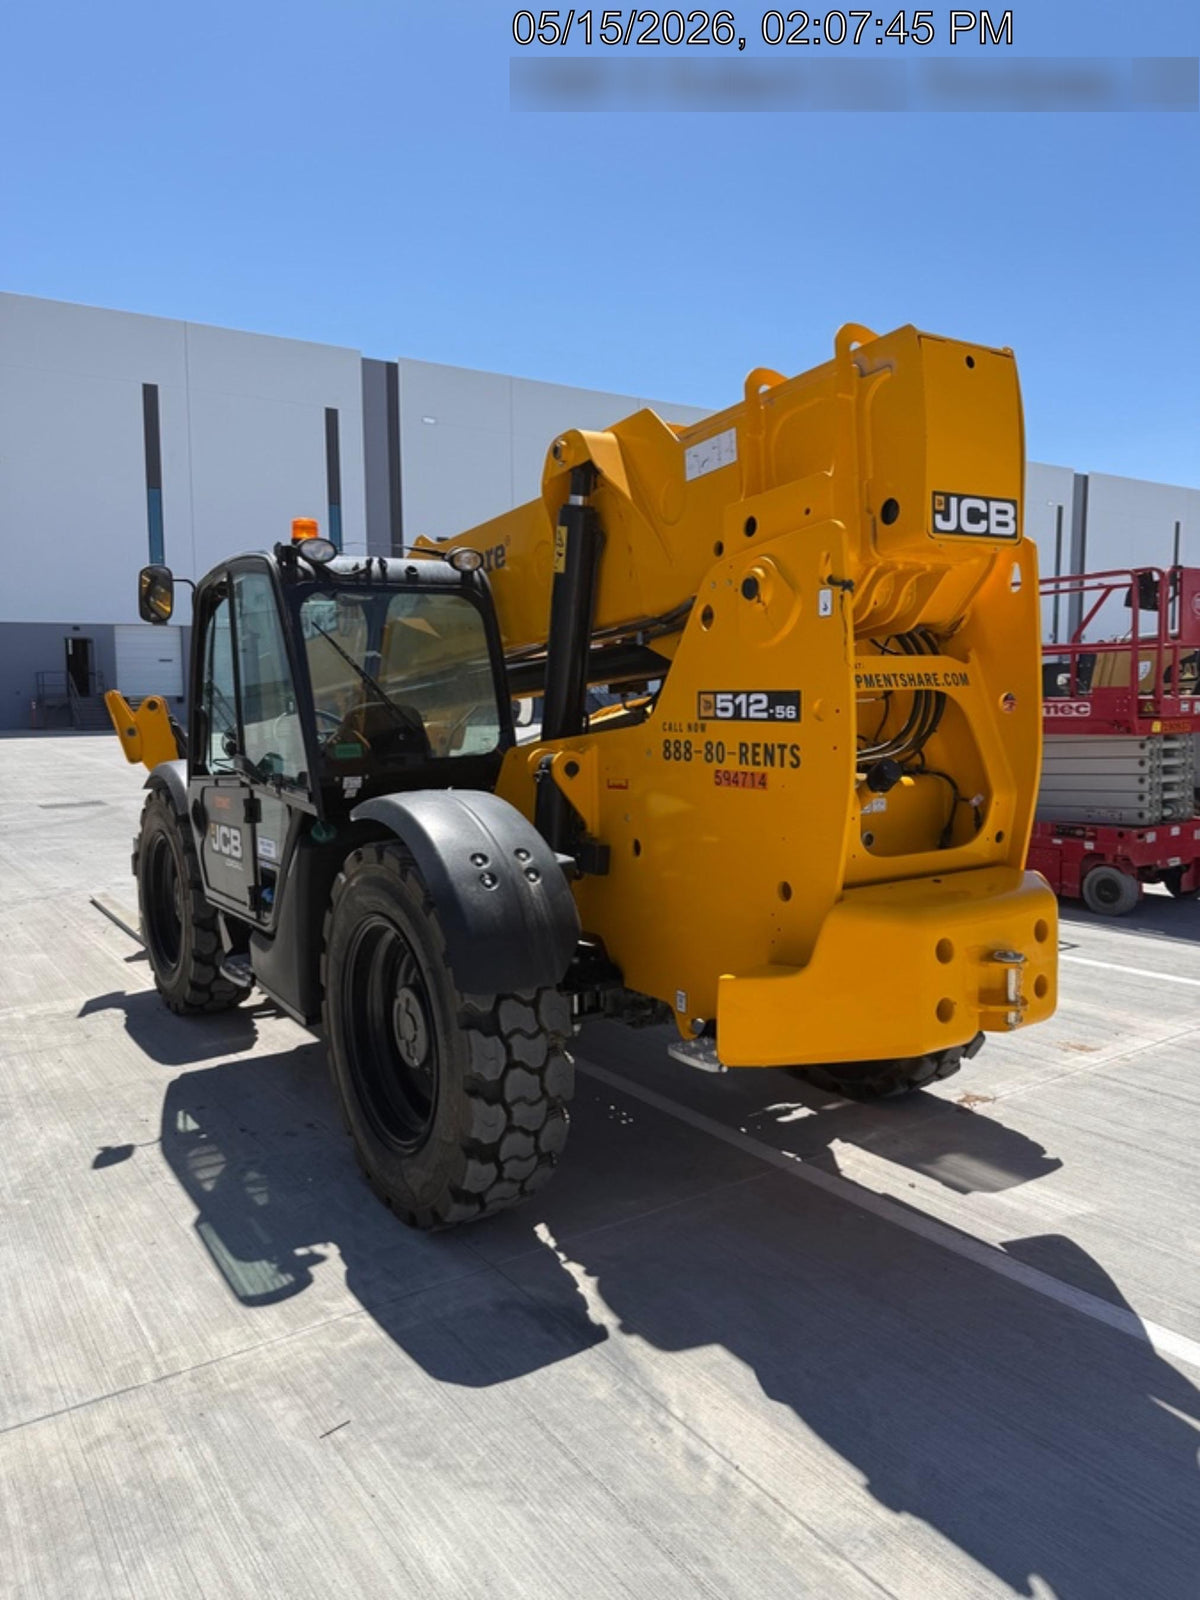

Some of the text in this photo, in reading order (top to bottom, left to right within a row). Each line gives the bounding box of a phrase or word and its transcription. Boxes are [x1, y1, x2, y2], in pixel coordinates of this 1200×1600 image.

[935, 496, 1016, 535] JCB
[662, 722, 683, 733] CALL
[662, 739, 801, 769] 888-80-RENTS
[714, 769, 767, 789] 594714
[210, 823, 242, 858] JCB
